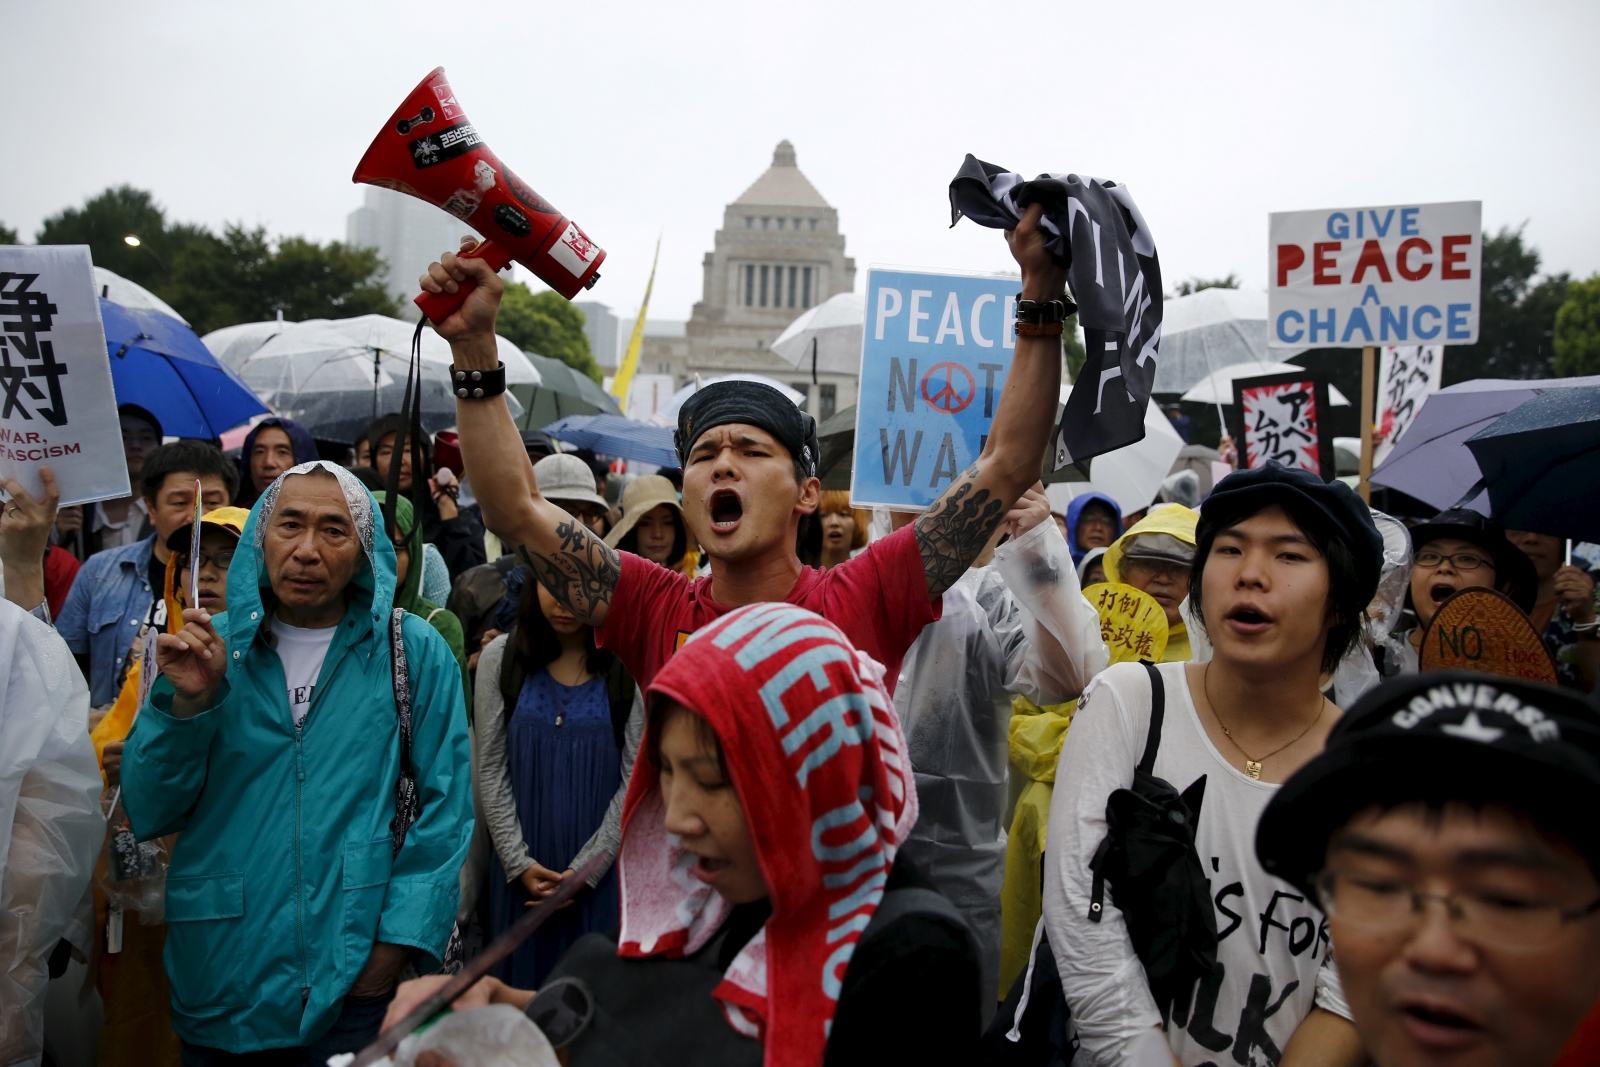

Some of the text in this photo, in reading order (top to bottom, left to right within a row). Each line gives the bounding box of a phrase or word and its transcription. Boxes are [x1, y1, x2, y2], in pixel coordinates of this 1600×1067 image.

[1327, 208, 1420, 239] GIVE
[1277, 234, 1472, 287] PEACE
[875, 287, 1016, 349] PEACE
[1361, 285, 1380, 305] A
[1277, 303, 1471, 343] CHANCE
[1277, 390, 1314, 444] アベ
[880, 428, 987, 488] WA
[1438, 623, 1483, 661] NO
[684, 602, 874, 790] WER
[1391, 682, 1562, 744] CONVERSE
